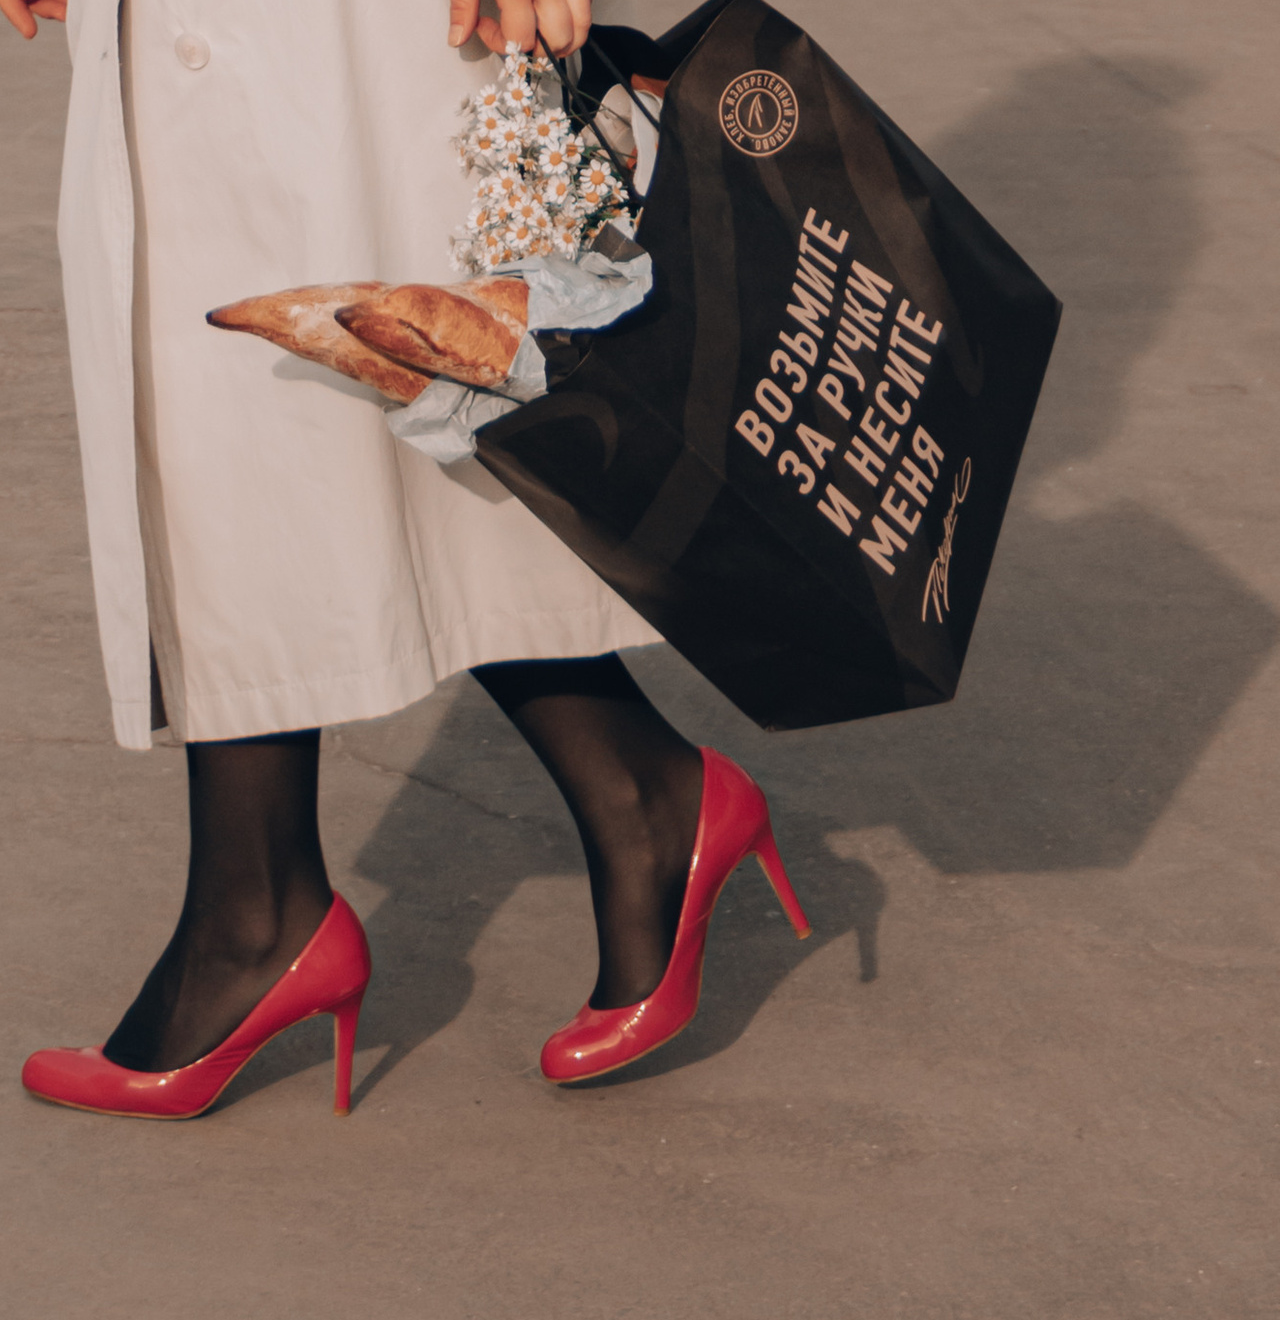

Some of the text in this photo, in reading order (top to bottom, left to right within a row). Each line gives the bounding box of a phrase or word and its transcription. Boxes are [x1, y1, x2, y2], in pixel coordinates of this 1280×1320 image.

[734, 206, 850, 457] ВОЗЬМИТЕ
[777, 259, 894, 495] ЗА РУЧКИ
[816, 298, 944, 537] И НЕСИТЕ
[858, 424, 945, 576] МЕНЯ
